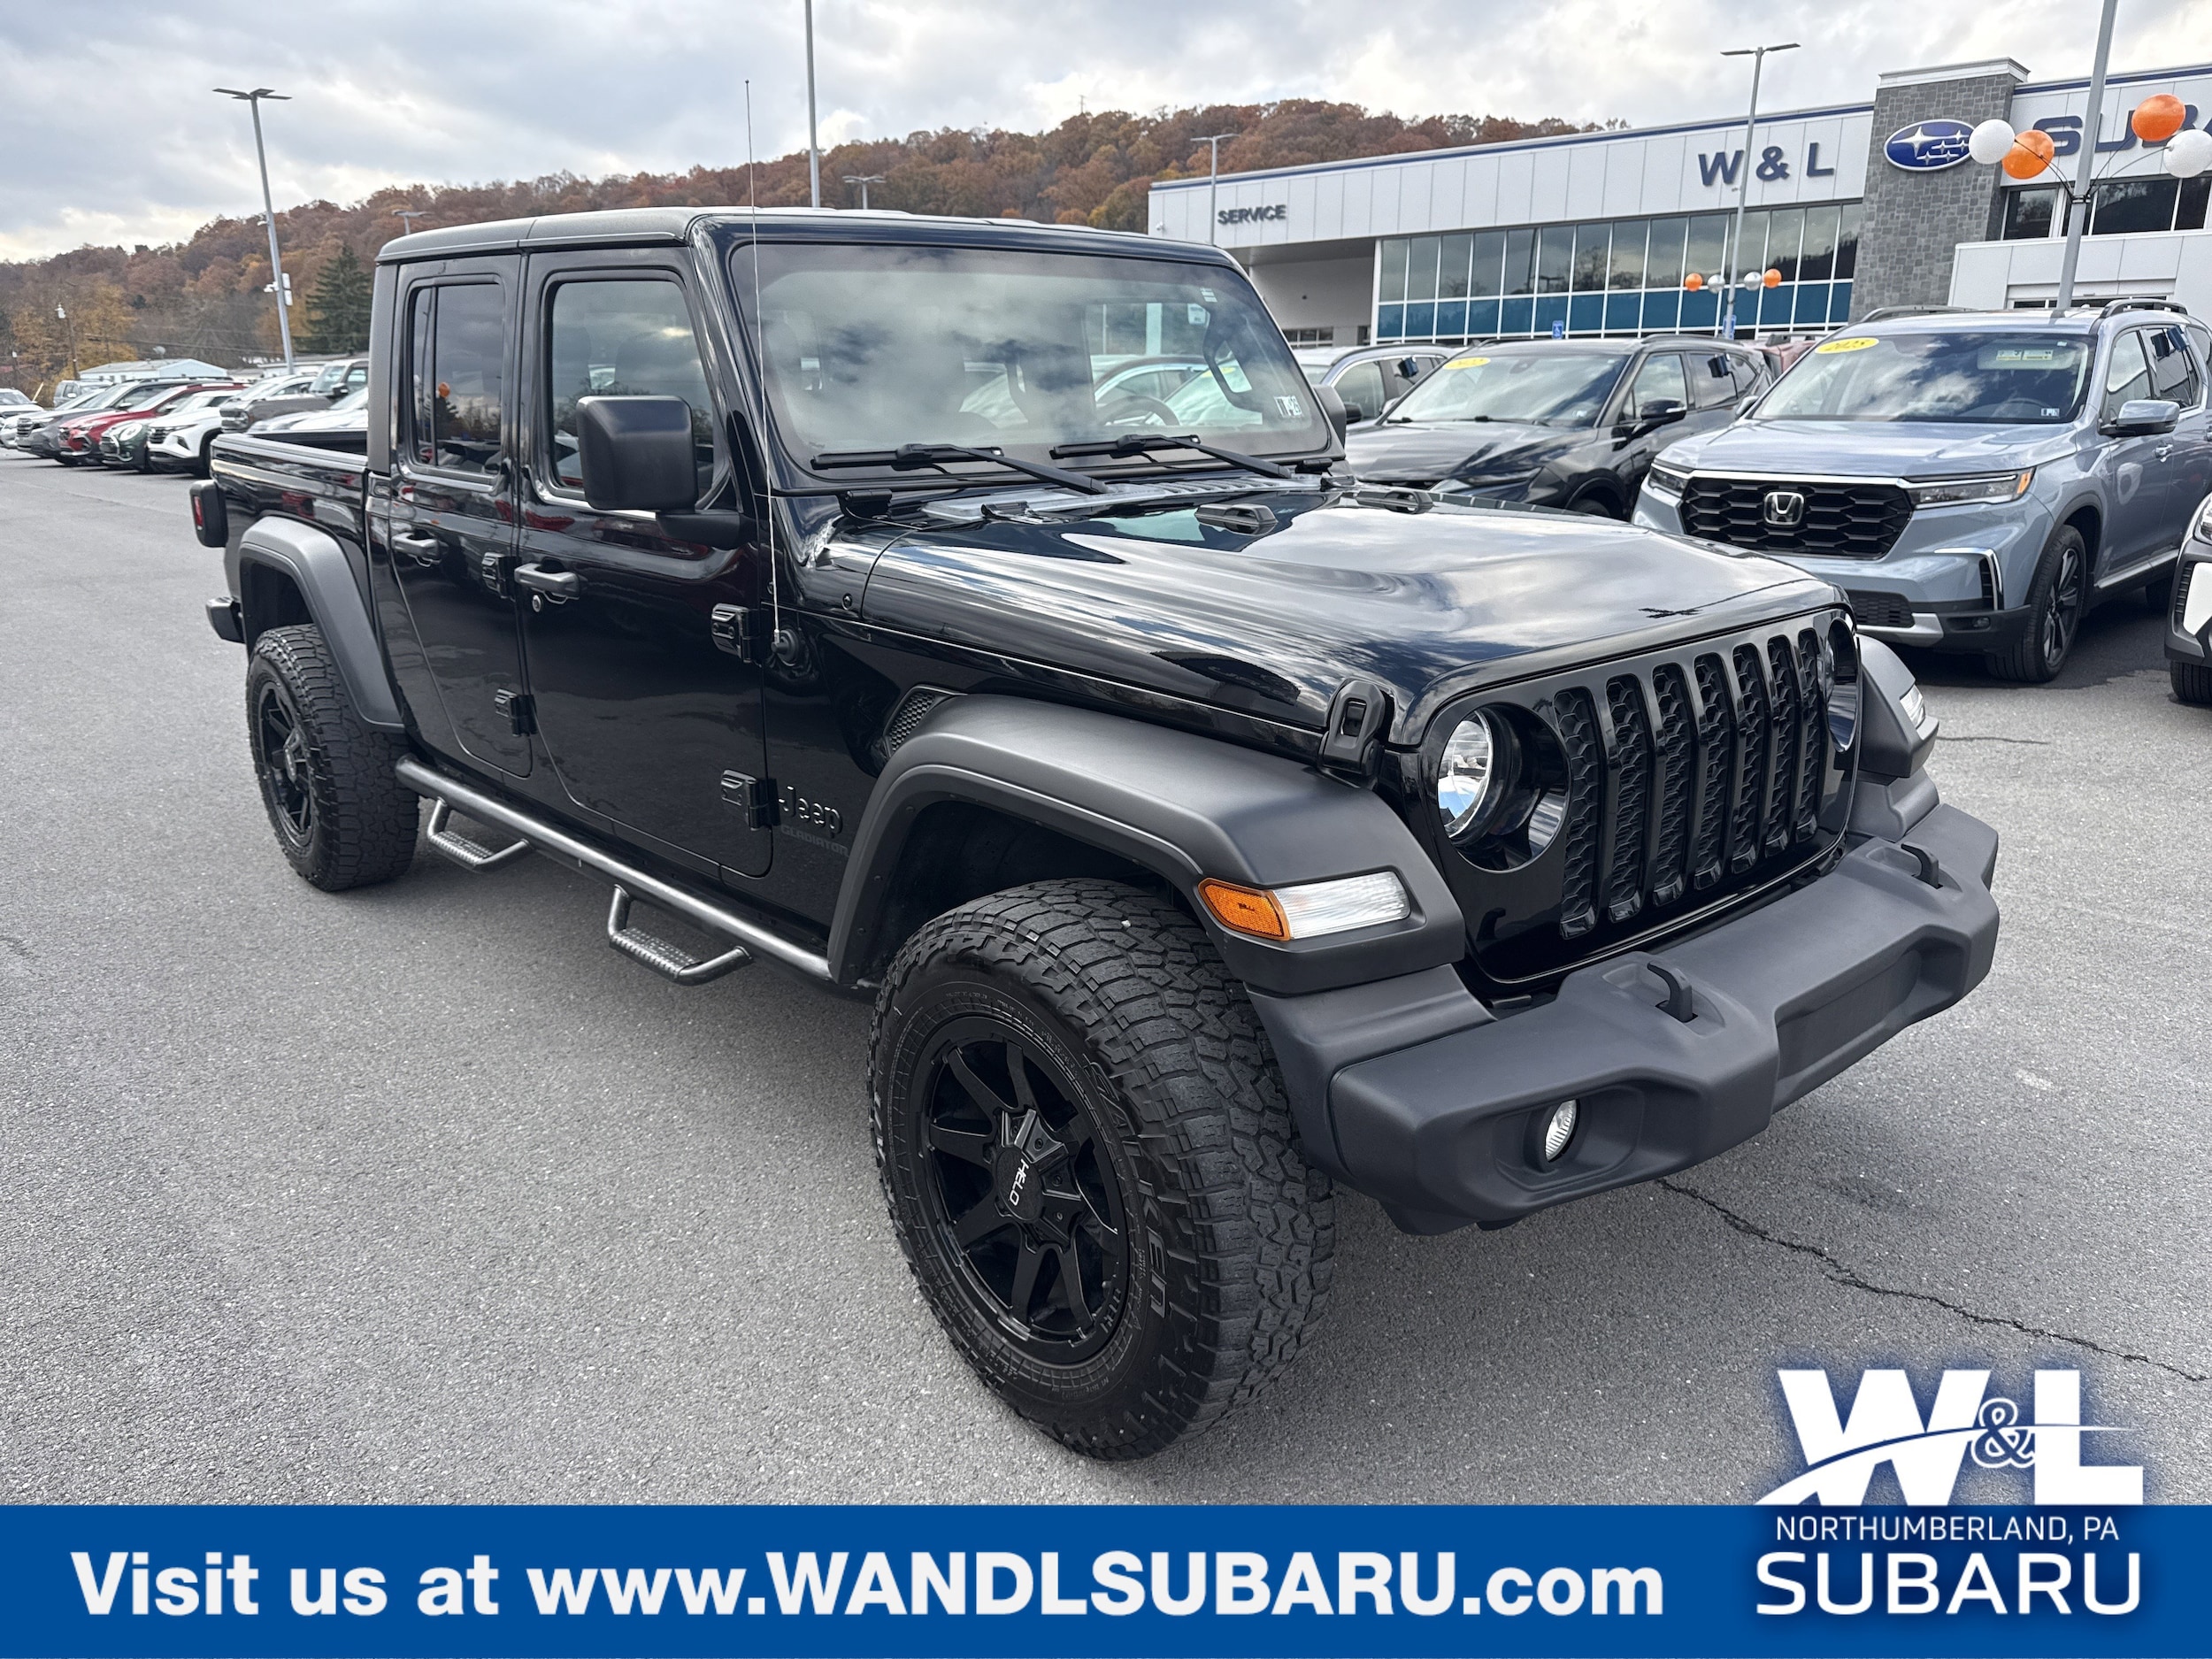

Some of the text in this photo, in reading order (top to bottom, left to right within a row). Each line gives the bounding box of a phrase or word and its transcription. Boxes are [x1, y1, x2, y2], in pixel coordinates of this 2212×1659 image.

[1698, 142, 1834, 187] W & L
[1217, 204, 1286, 225] SERVICE
[779, 786, 842, 838] Jeep
[780, 824, 849, 857] GLADIATOR
[1010, 1158, 1029, 1206] HELO
